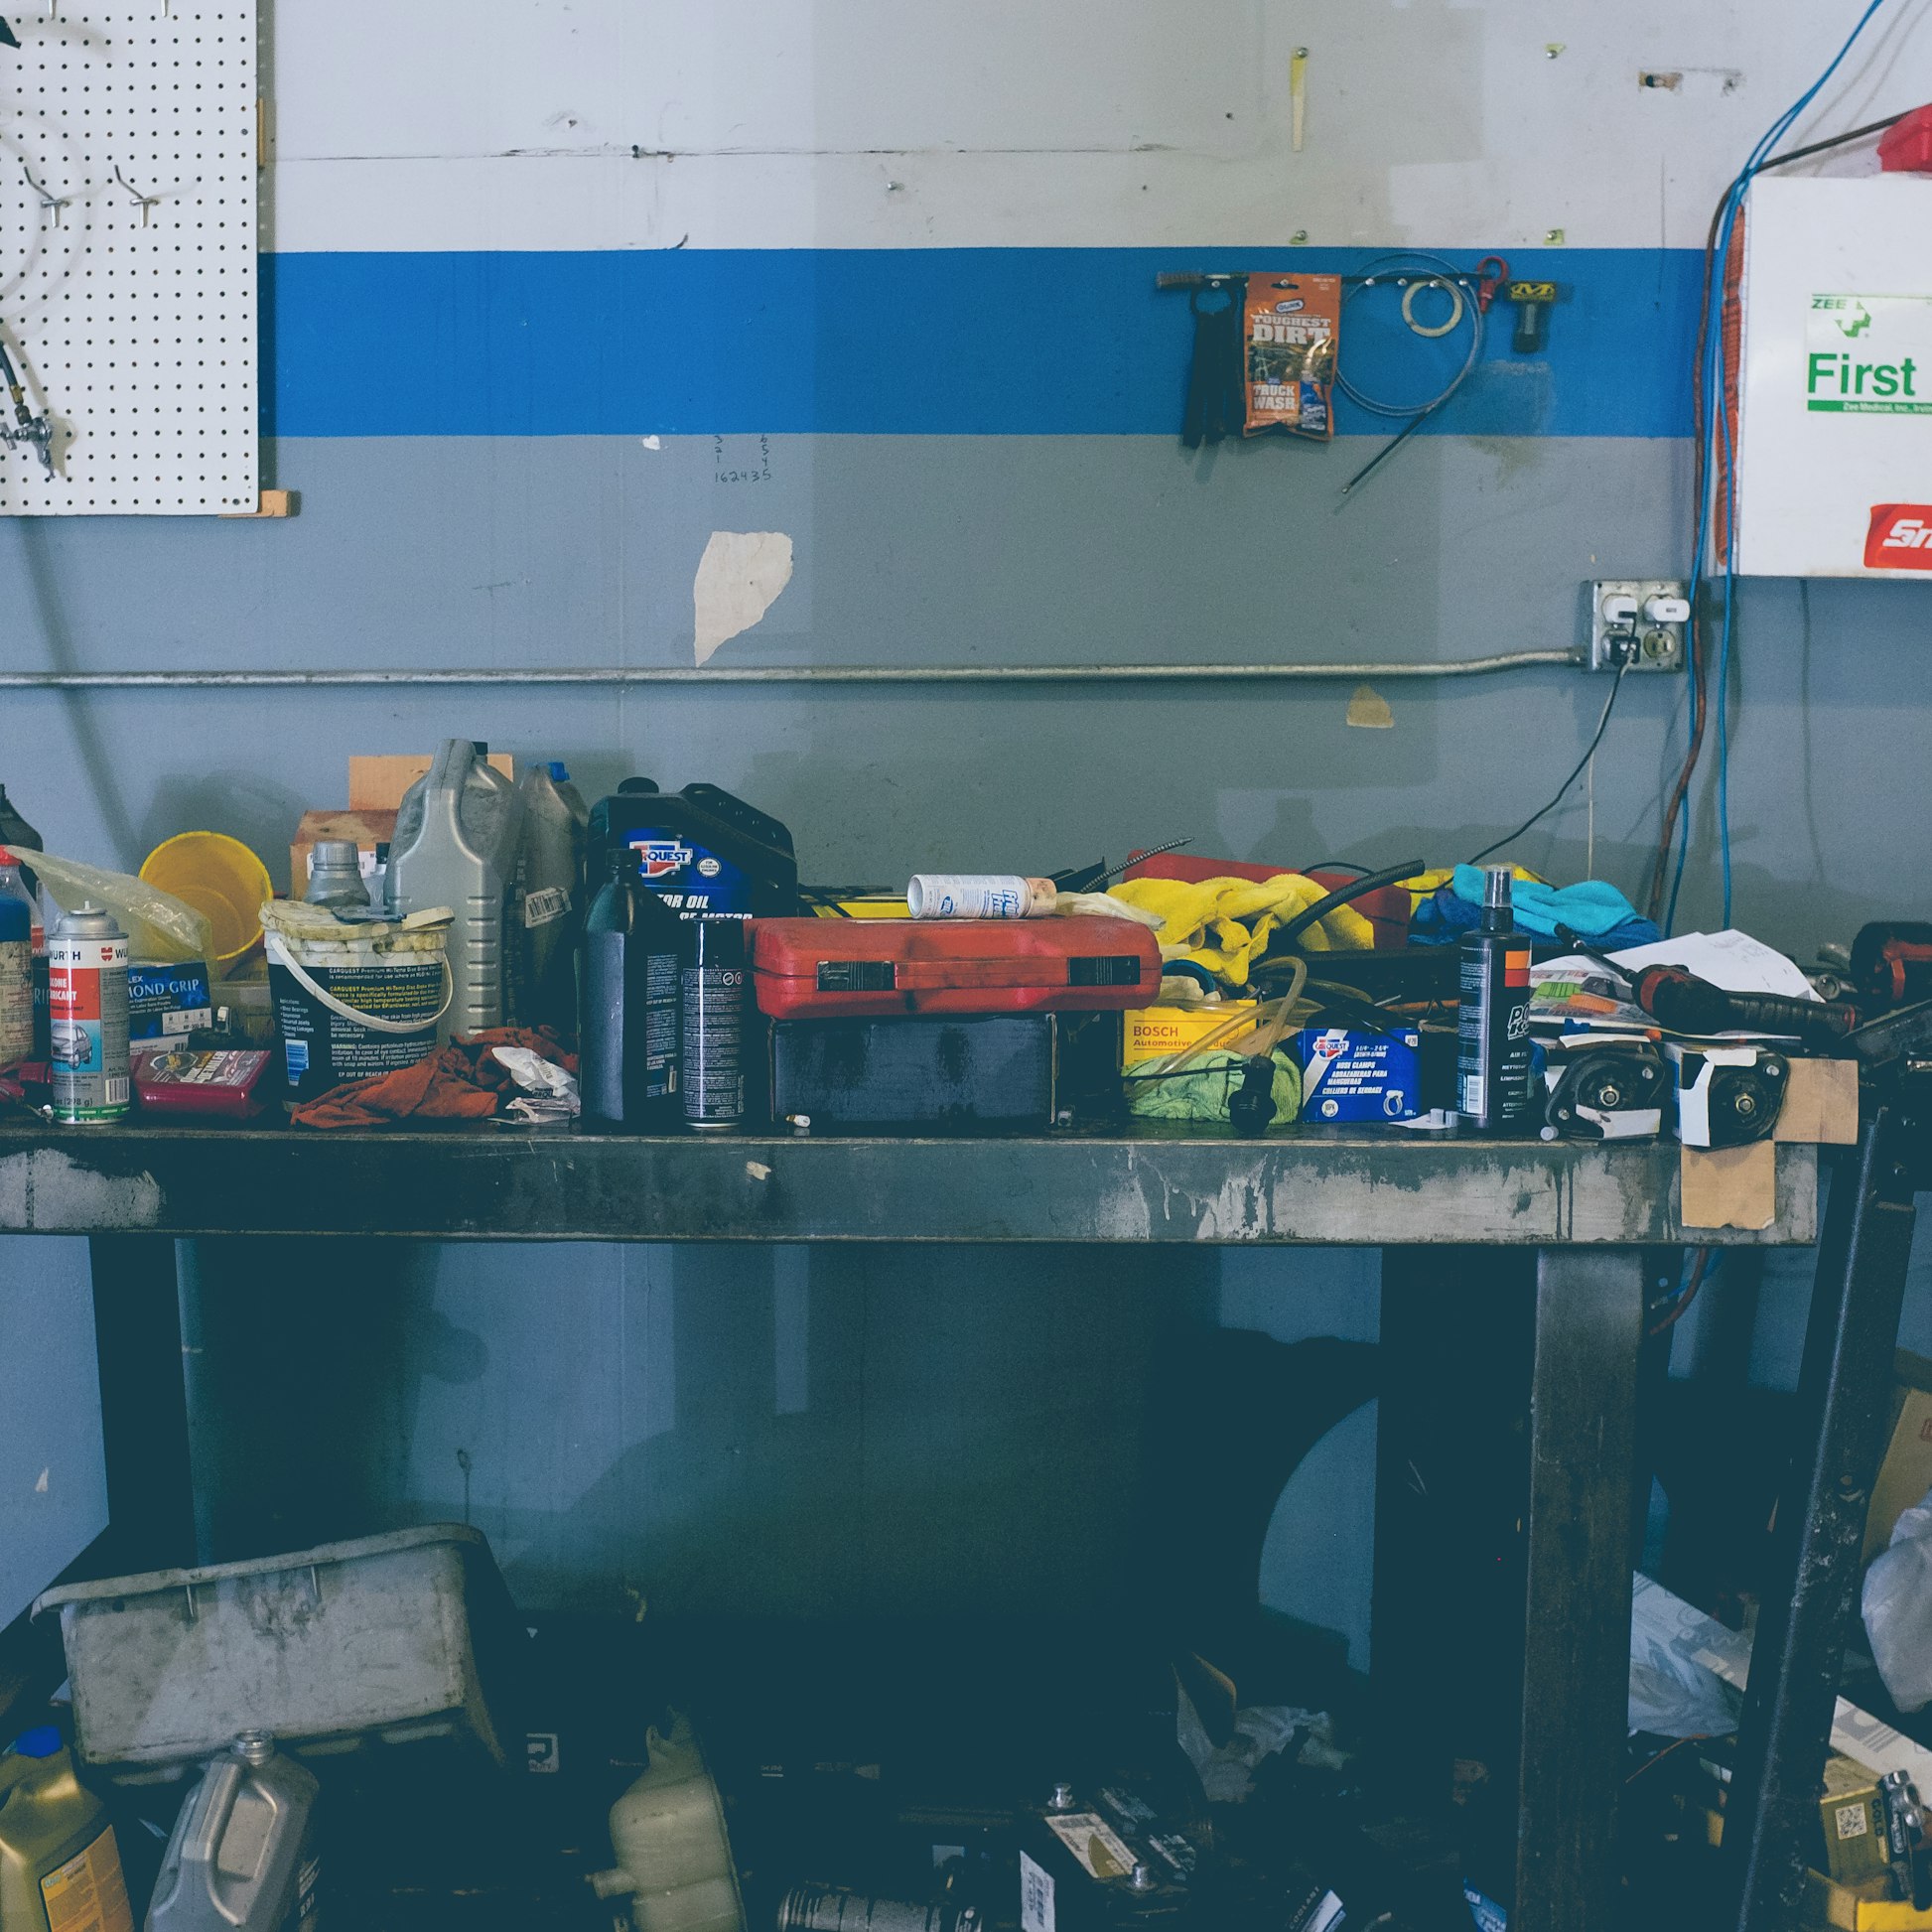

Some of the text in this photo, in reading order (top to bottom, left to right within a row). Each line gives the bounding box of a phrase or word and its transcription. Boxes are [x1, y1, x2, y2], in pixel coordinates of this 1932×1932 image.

[1811, 299, 1847, 310] ZEE
[1253, 315, 1331, 328] TOUGHEST
[1253, 324, 1331, 345] DIRT
[1808, 352, 1917, 396] First
[1253, 384, 1296, 396] TRUCK
[1253, 396, 1296, 410] WASH
[714, 435, 723, 444] 3
[761, 444, 769, 456] 5
[761, 457, 767, 467] 4
[686, 895, 709, 908] OIL
[169, 979, 200, 994] GRIP
[1133, 1026, 1178, 1036] BOSCH
[1314, 1041, 1346, 1050] CARQUEST
[84, 1098, 93, 1107] g)
[1871, 1798, 1883, 1837] GOLD
